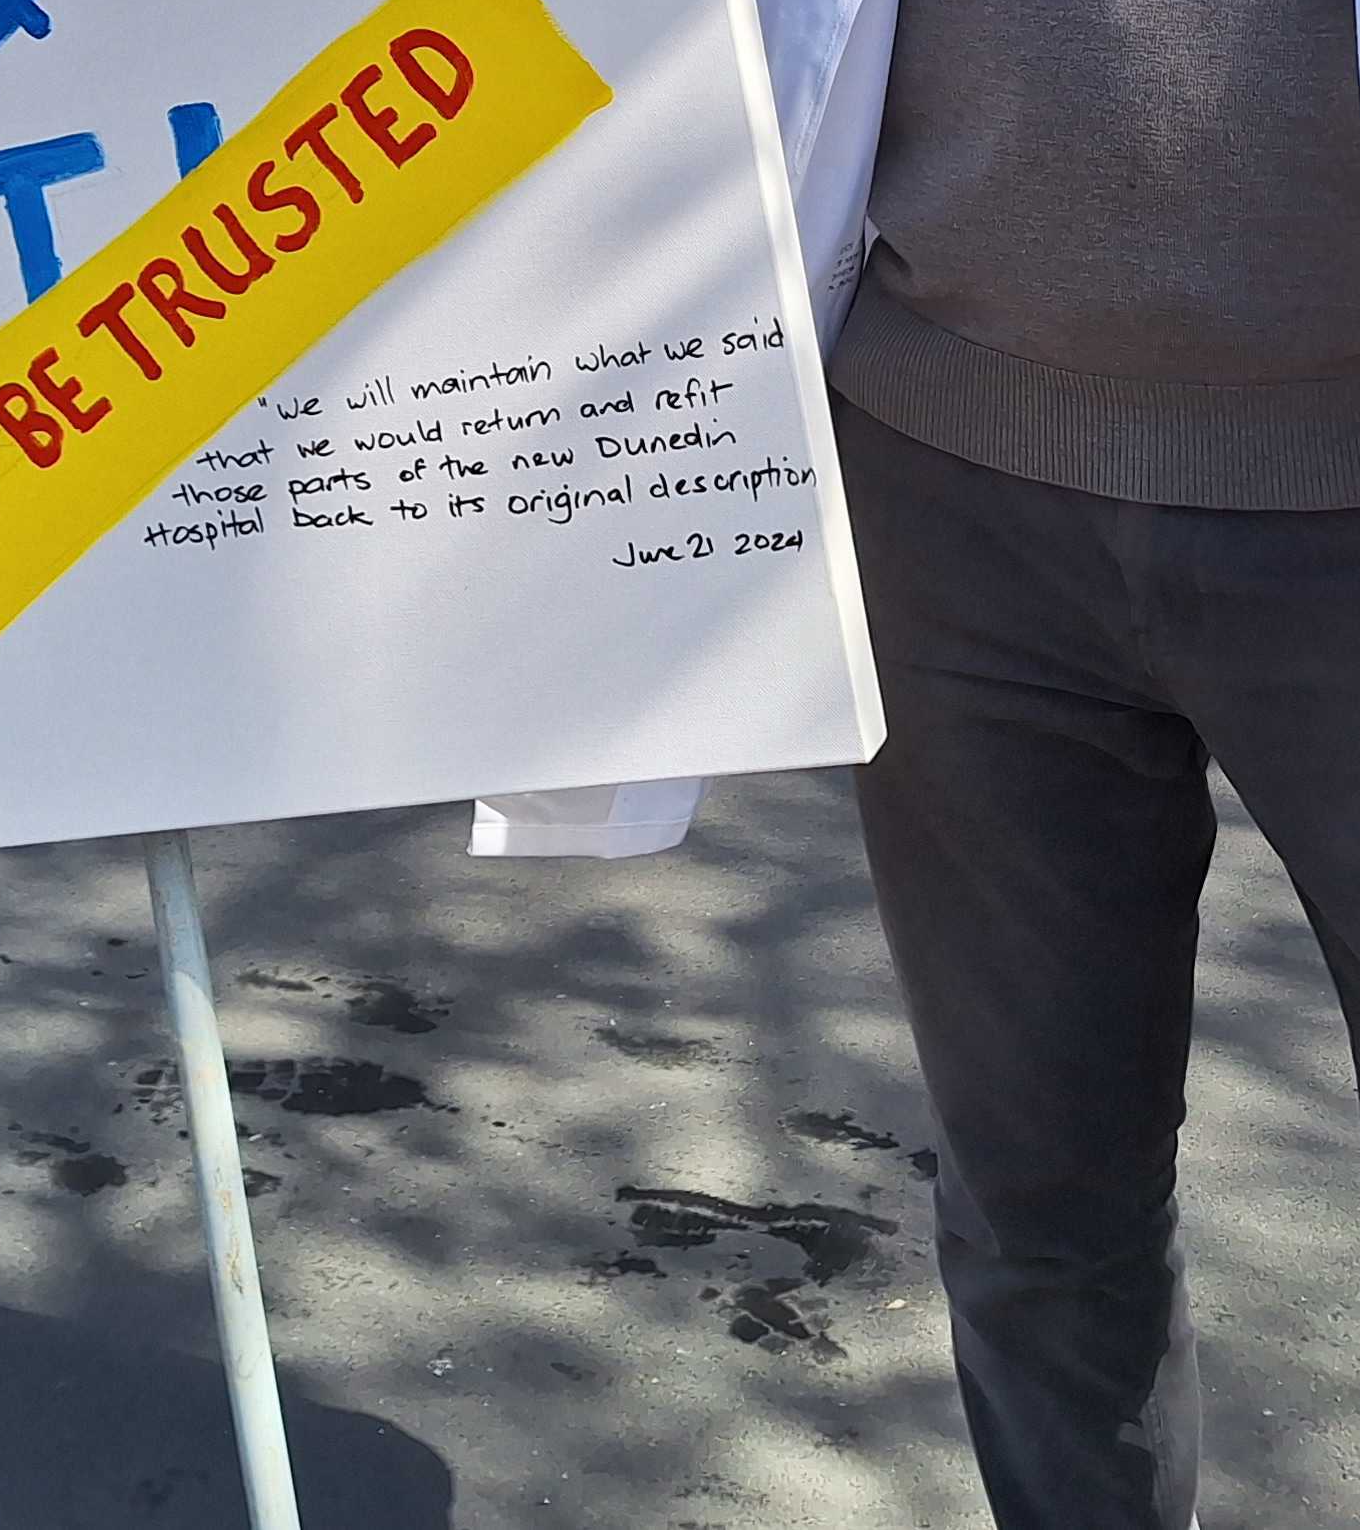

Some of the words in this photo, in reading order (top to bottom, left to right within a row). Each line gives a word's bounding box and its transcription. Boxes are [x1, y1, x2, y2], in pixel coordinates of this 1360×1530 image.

[78, 26, 476, 381] TRUSTED
[346, 374, 396, 410] will
[411, 355, 552, 399] maintain
[575, 341, 652, 372] what
[664, 337, 704, 362] we
[721, 317, 784, 356] said
[172, 482, 268, 507] those
[287, 467, 372, 505] parts
[399, 458, 428, 482] of
[439, 454, 489, 479] the
[511, 447, 574, 471] new
[595, 418, 737, 458] Dunedin
[196, 439, 274, 471] that
[296, 437, 335, 460] we
[354, 419, 443, 451] would
[461, 406, 560, 437] return
[579, 391, 635, 419] and
[655, 377, 733, 411] refit
[144, 506, 264, 550] Hospital
[292, 504, 374, 529] back
[390, 499, 428, 521] to
[448, 493, 485, 518] its
[508, 474, 633, 525] original
[649, 455, 818, 503] description
